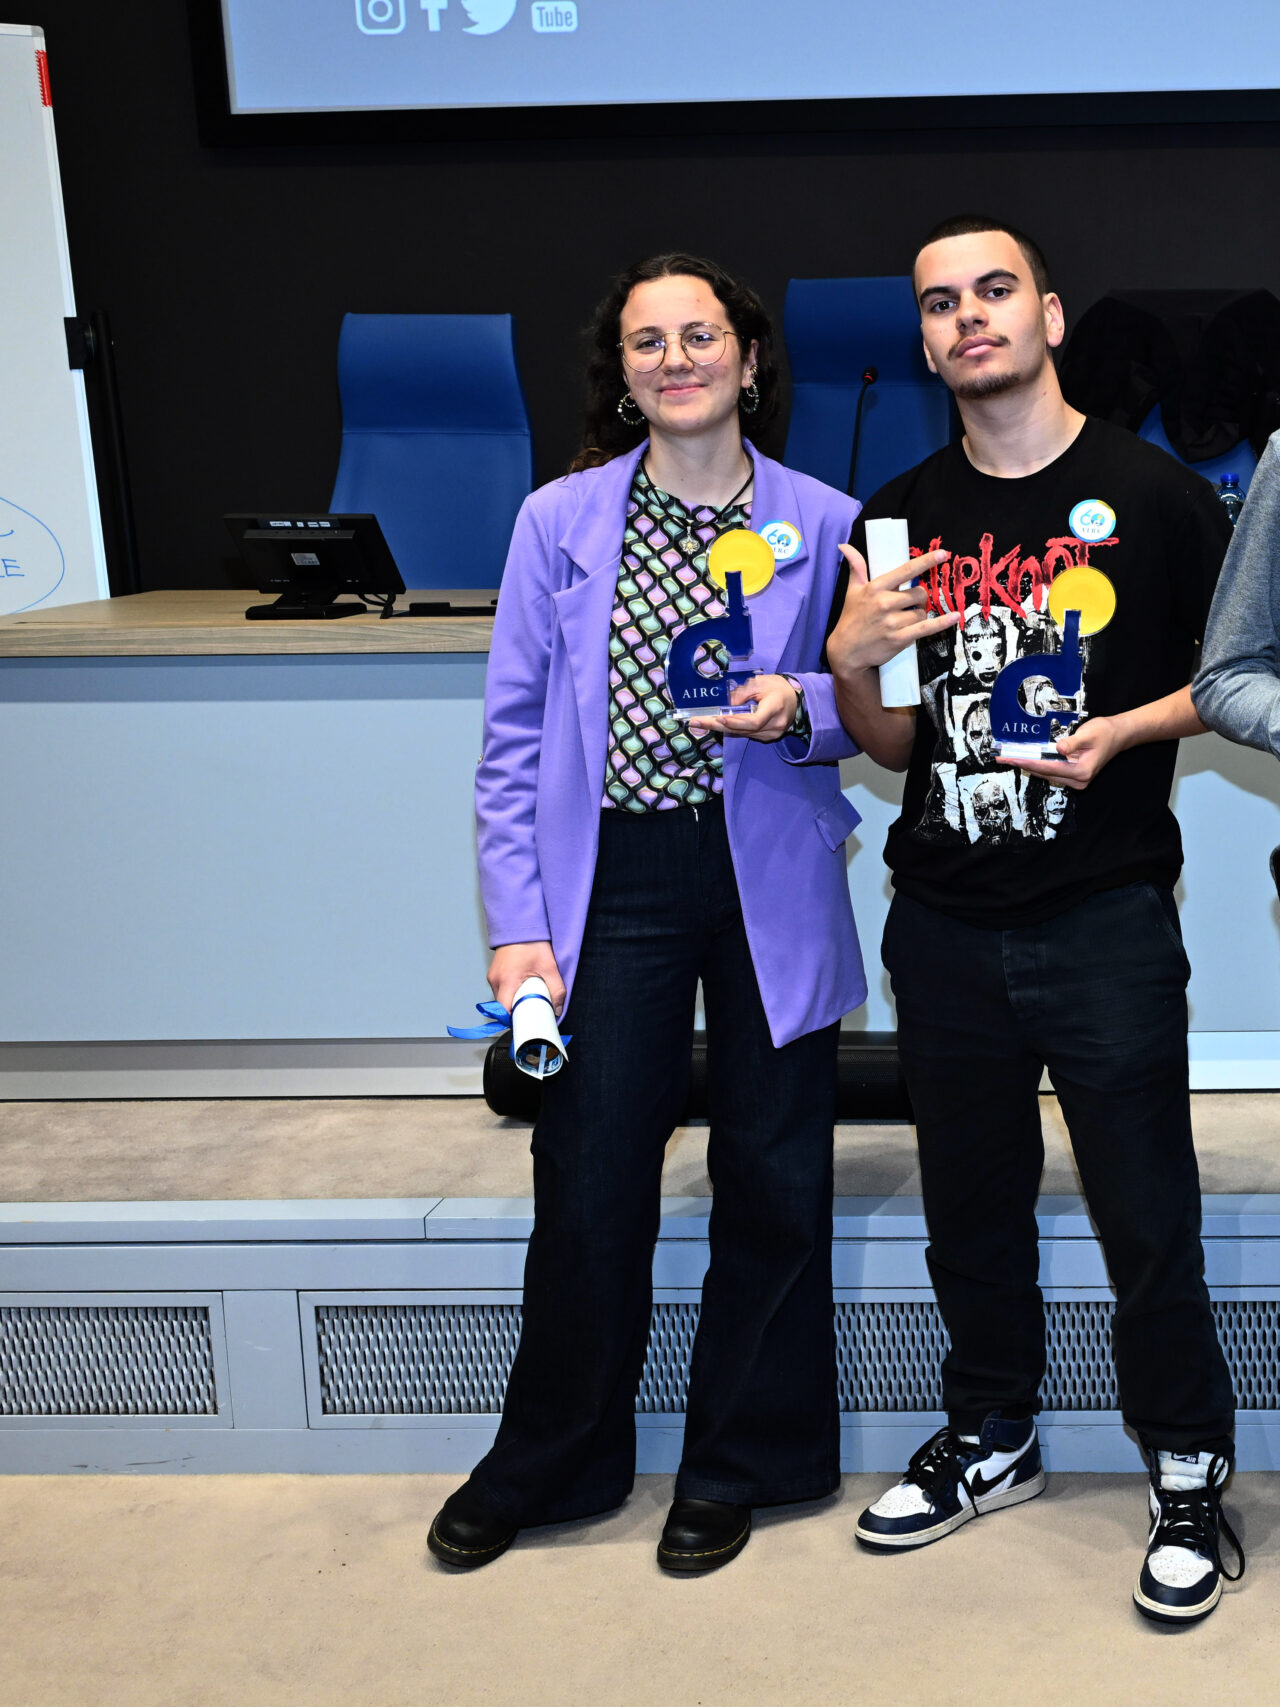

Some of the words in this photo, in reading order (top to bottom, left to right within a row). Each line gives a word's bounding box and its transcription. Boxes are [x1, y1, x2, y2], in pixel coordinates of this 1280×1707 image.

[536, 6, 573, 28] Tube
[682, 686, 720, 699] AIRC
[1001, 721, 1041, 735] AIRC
